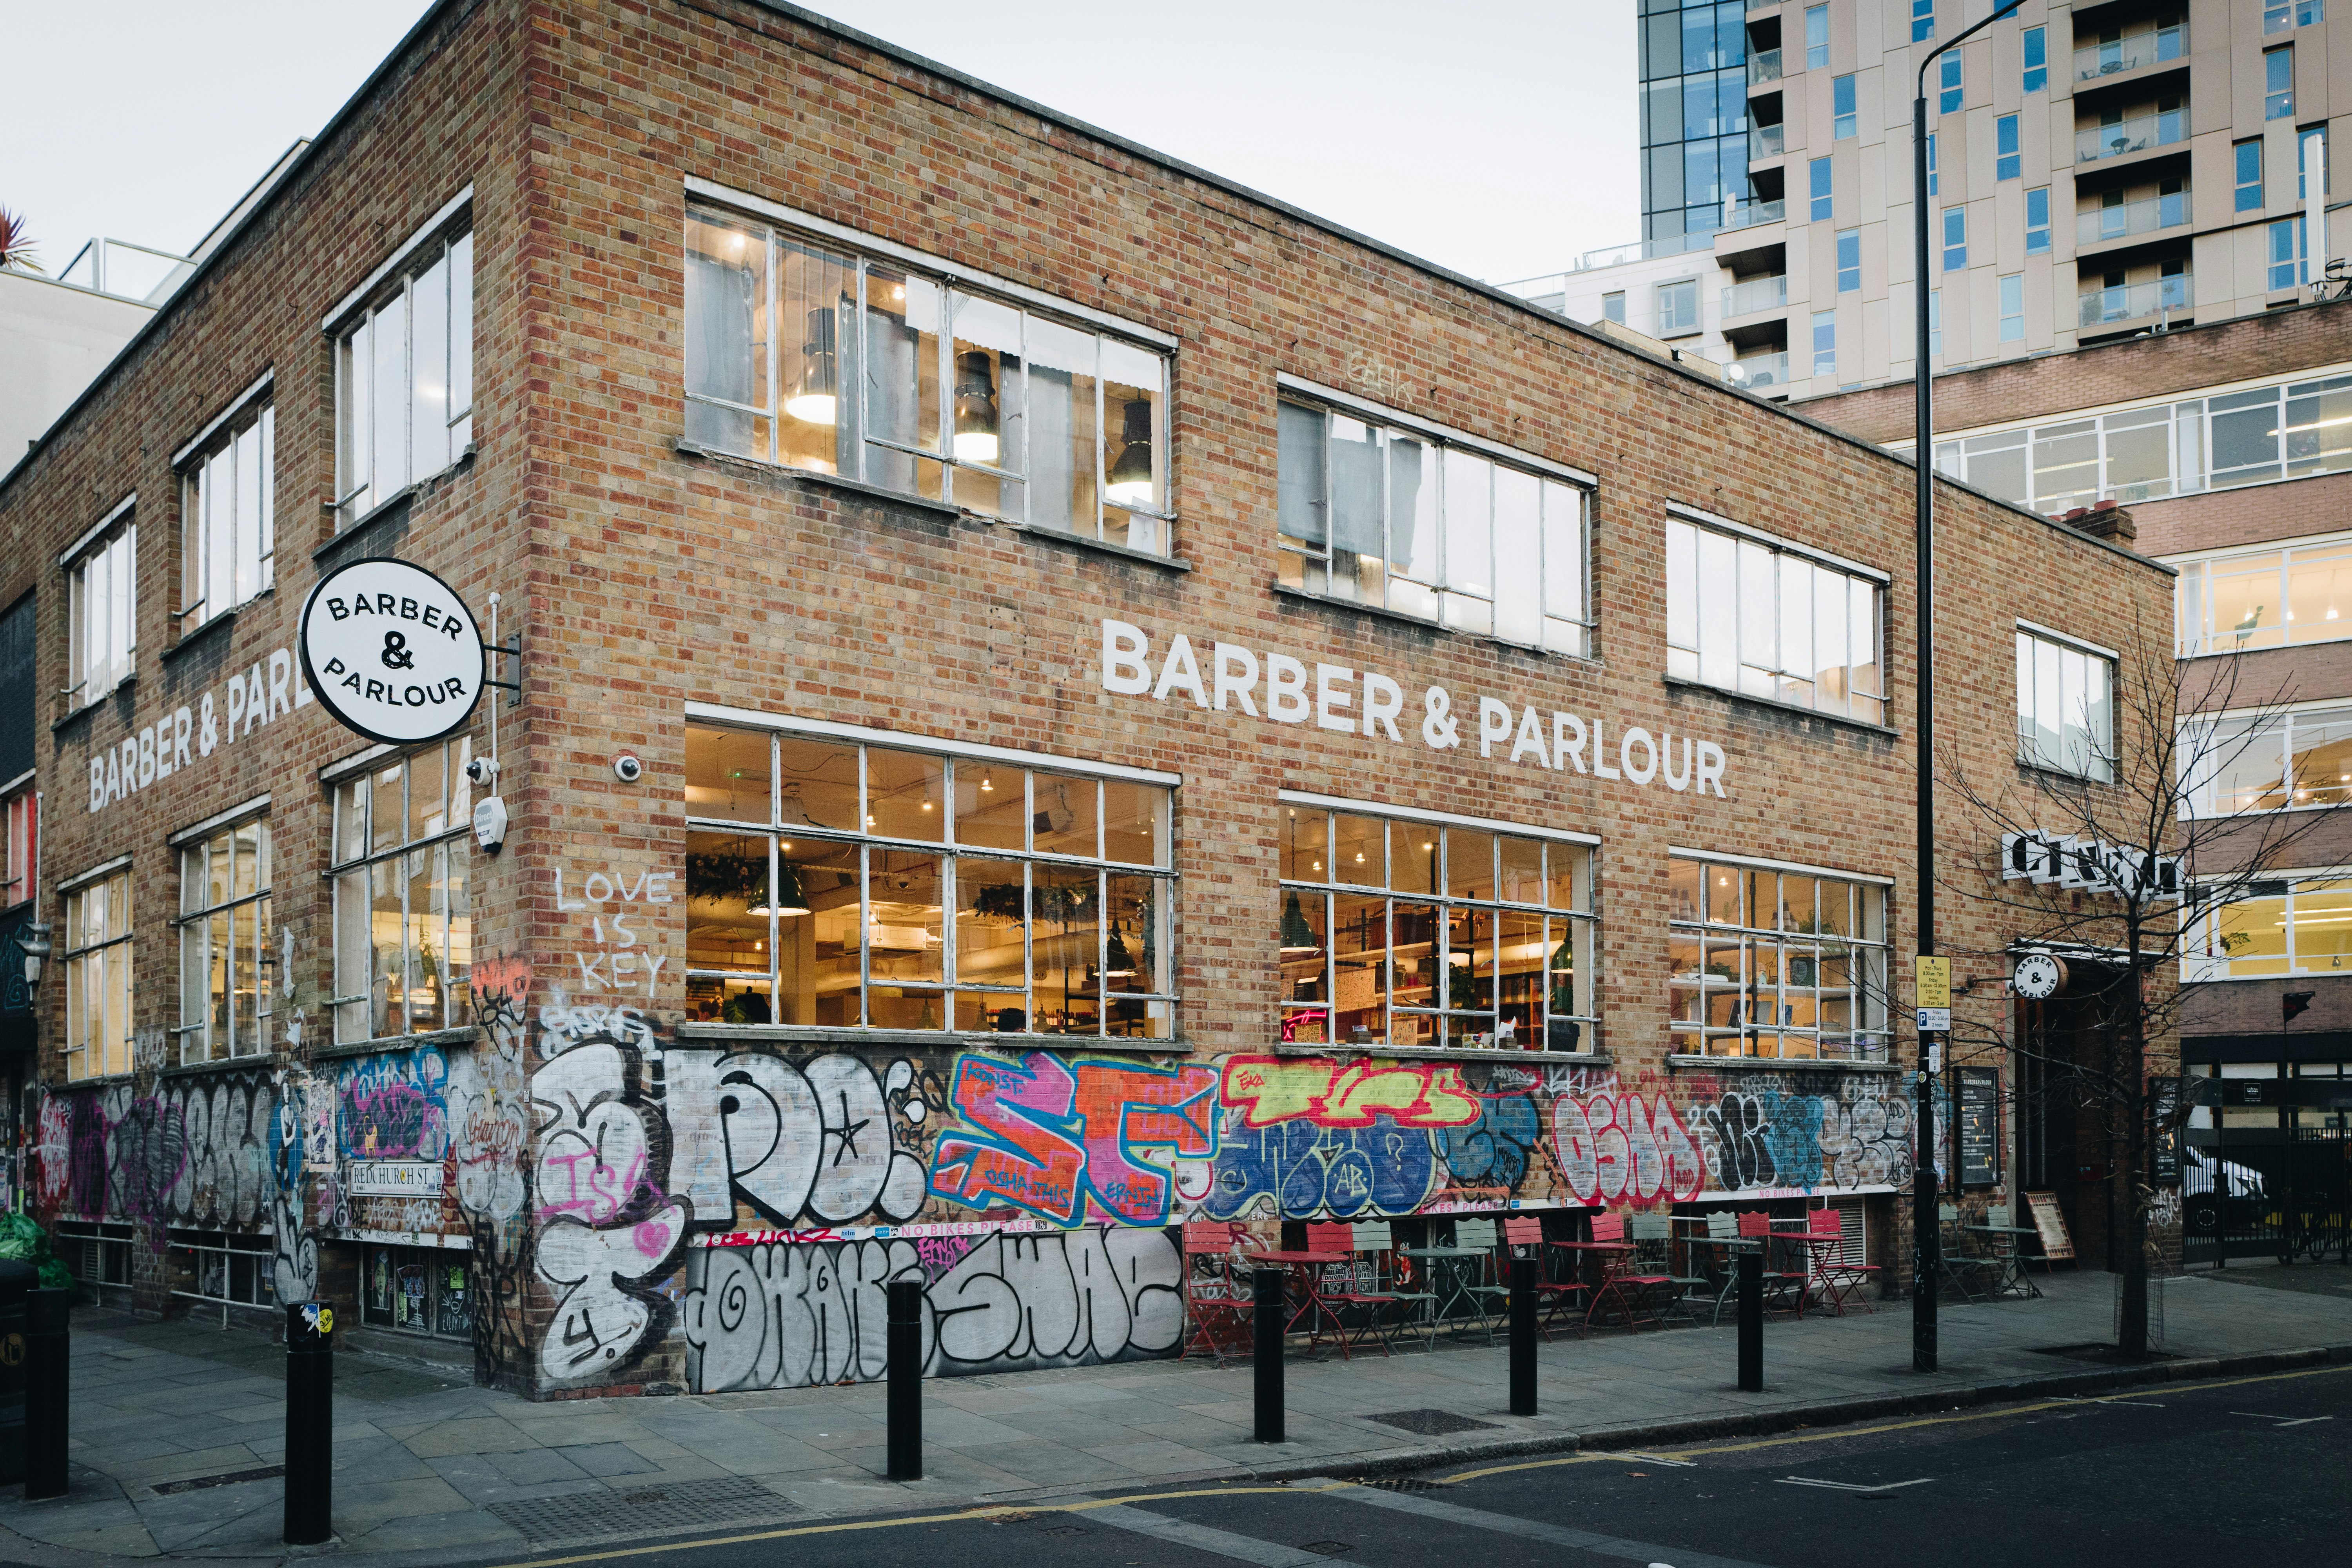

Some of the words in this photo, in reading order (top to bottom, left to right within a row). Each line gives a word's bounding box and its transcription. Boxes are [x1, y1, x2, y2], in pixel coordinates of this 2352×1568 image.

[326, 593, 463, 641] BARBER
[381, 631, 415, 670] &
[323, 657, 467, 707] PARLOUR
[1102, 618, 1404, 743] BARBER
[1422, 686, 1461, 750] &
[1480, 696, 1727, 799] PARLOUR
[90, 706, 192, 813] BARBER
[200, 692, 218, 757] &
[228, 640, 314, 744] PARL
[475, 810, 492, 822] Direct
[555, 867, 675, 911] LOVE
[593, 913, 636, 948] IS
[577, 951, 666, 998] KEY
[2017, 957, 2052, 975] BARBER
[2031, 972, 2042, 984] &
[1920, 1013, 1926, 1025] P
[354, 1167, 414, 1184] REDCHURCH
[418, 1168, 429, 1185] ST
[1463, 1201, 1498, 1211] PLEASE
[1774, 1189, 1794, 1197] BIKES
[902, 1226, 924, 1237] NO
[931, 1223, 974, 1235] BIKES
[981, 1220, 1033, 1233] PLEASE
